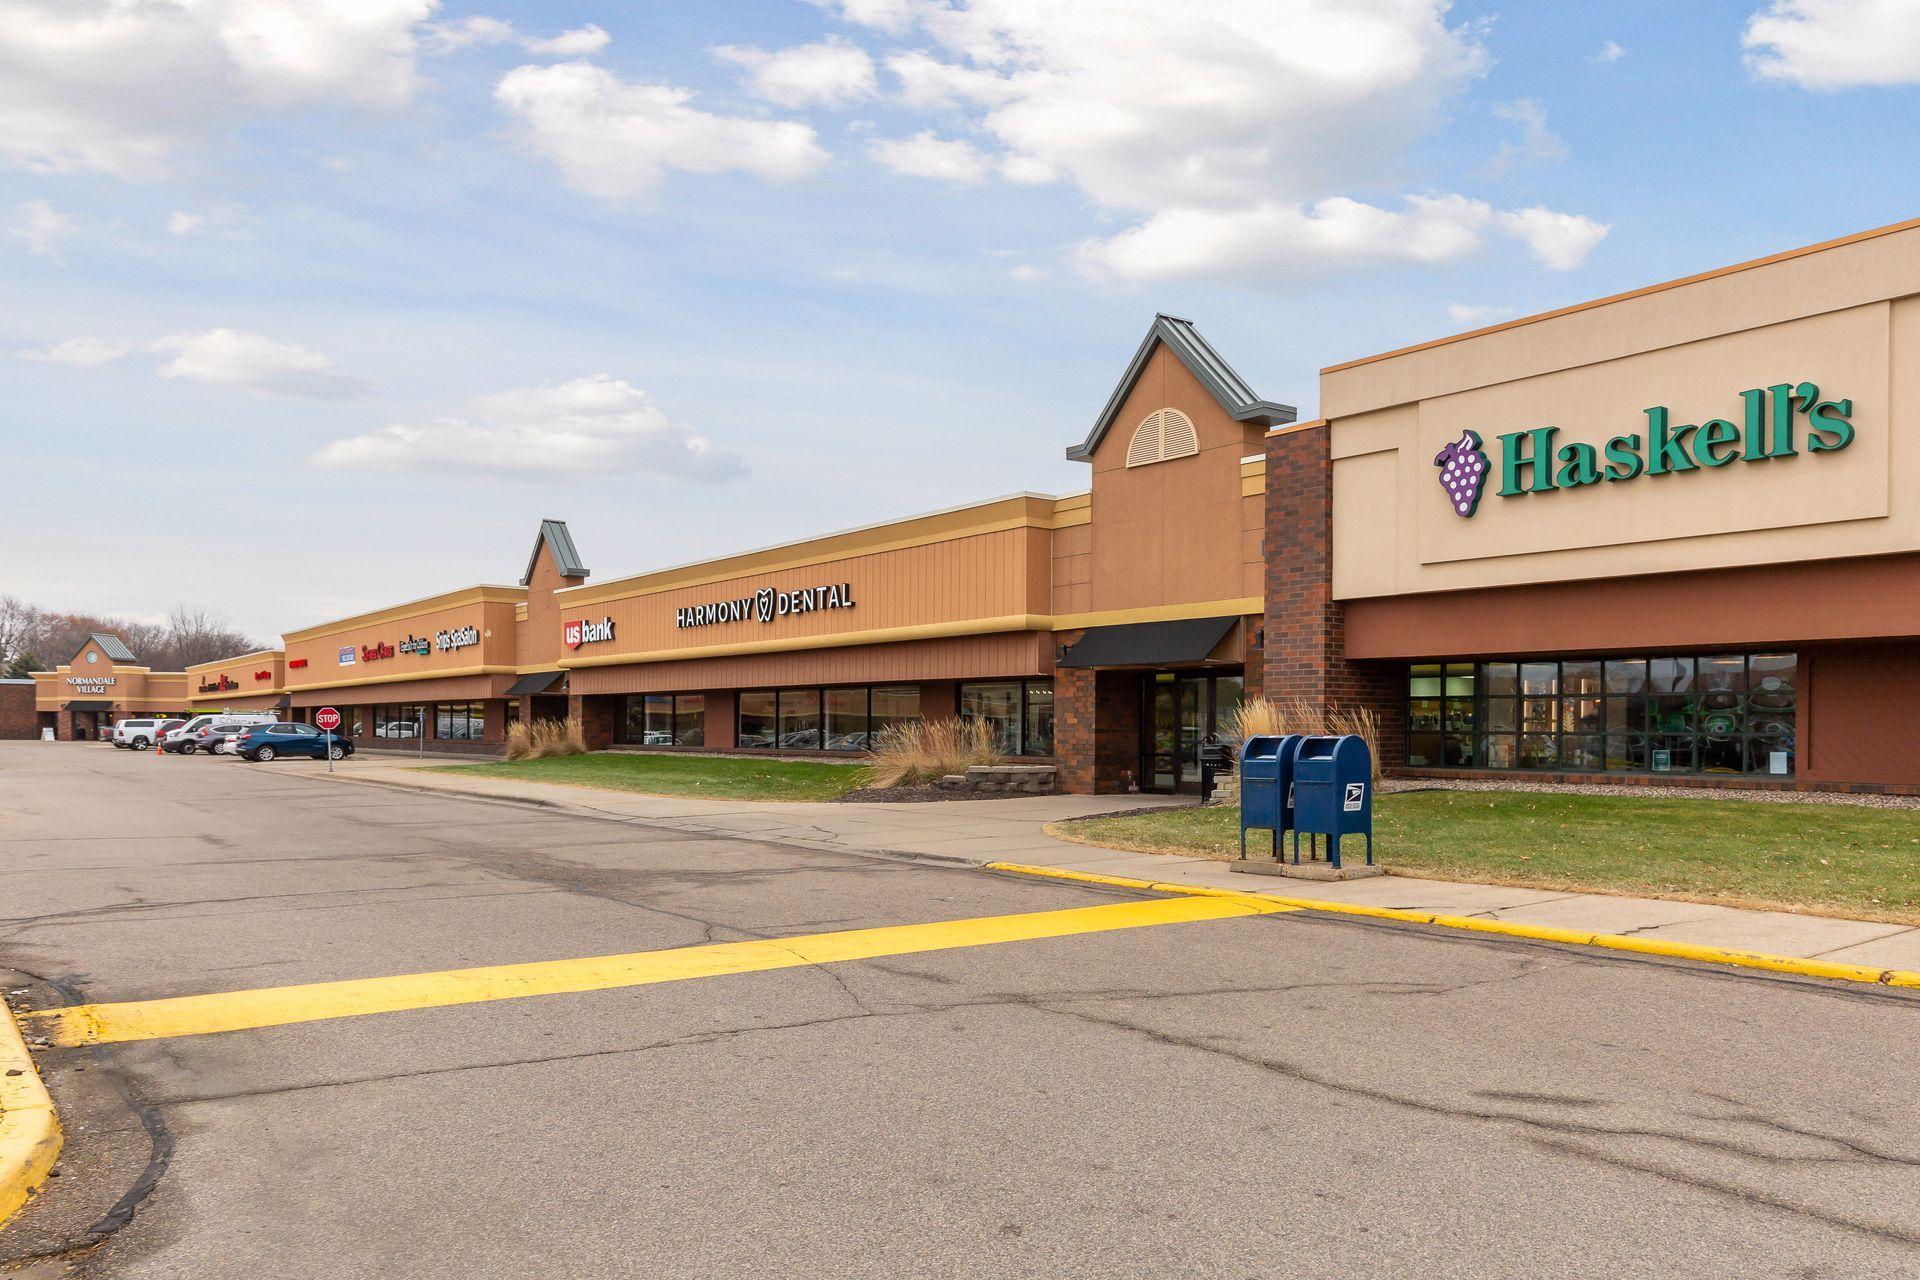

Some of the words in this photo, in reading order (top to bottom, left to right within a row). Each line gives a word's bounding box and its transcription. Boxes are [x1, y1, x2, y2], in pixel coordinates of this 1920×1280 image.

[1496, 381, 1855, 498] Haskell's
[676, 598, 753, 628] HARMONY
[778, 583, 855, 616] DENTAL
[582, 616, 614, 643] bank
[66, 677, 116, 685] NORMANDALE
[76, 686, 105, 694] VILLAGE
[318, 714, 339, 723] STOP
